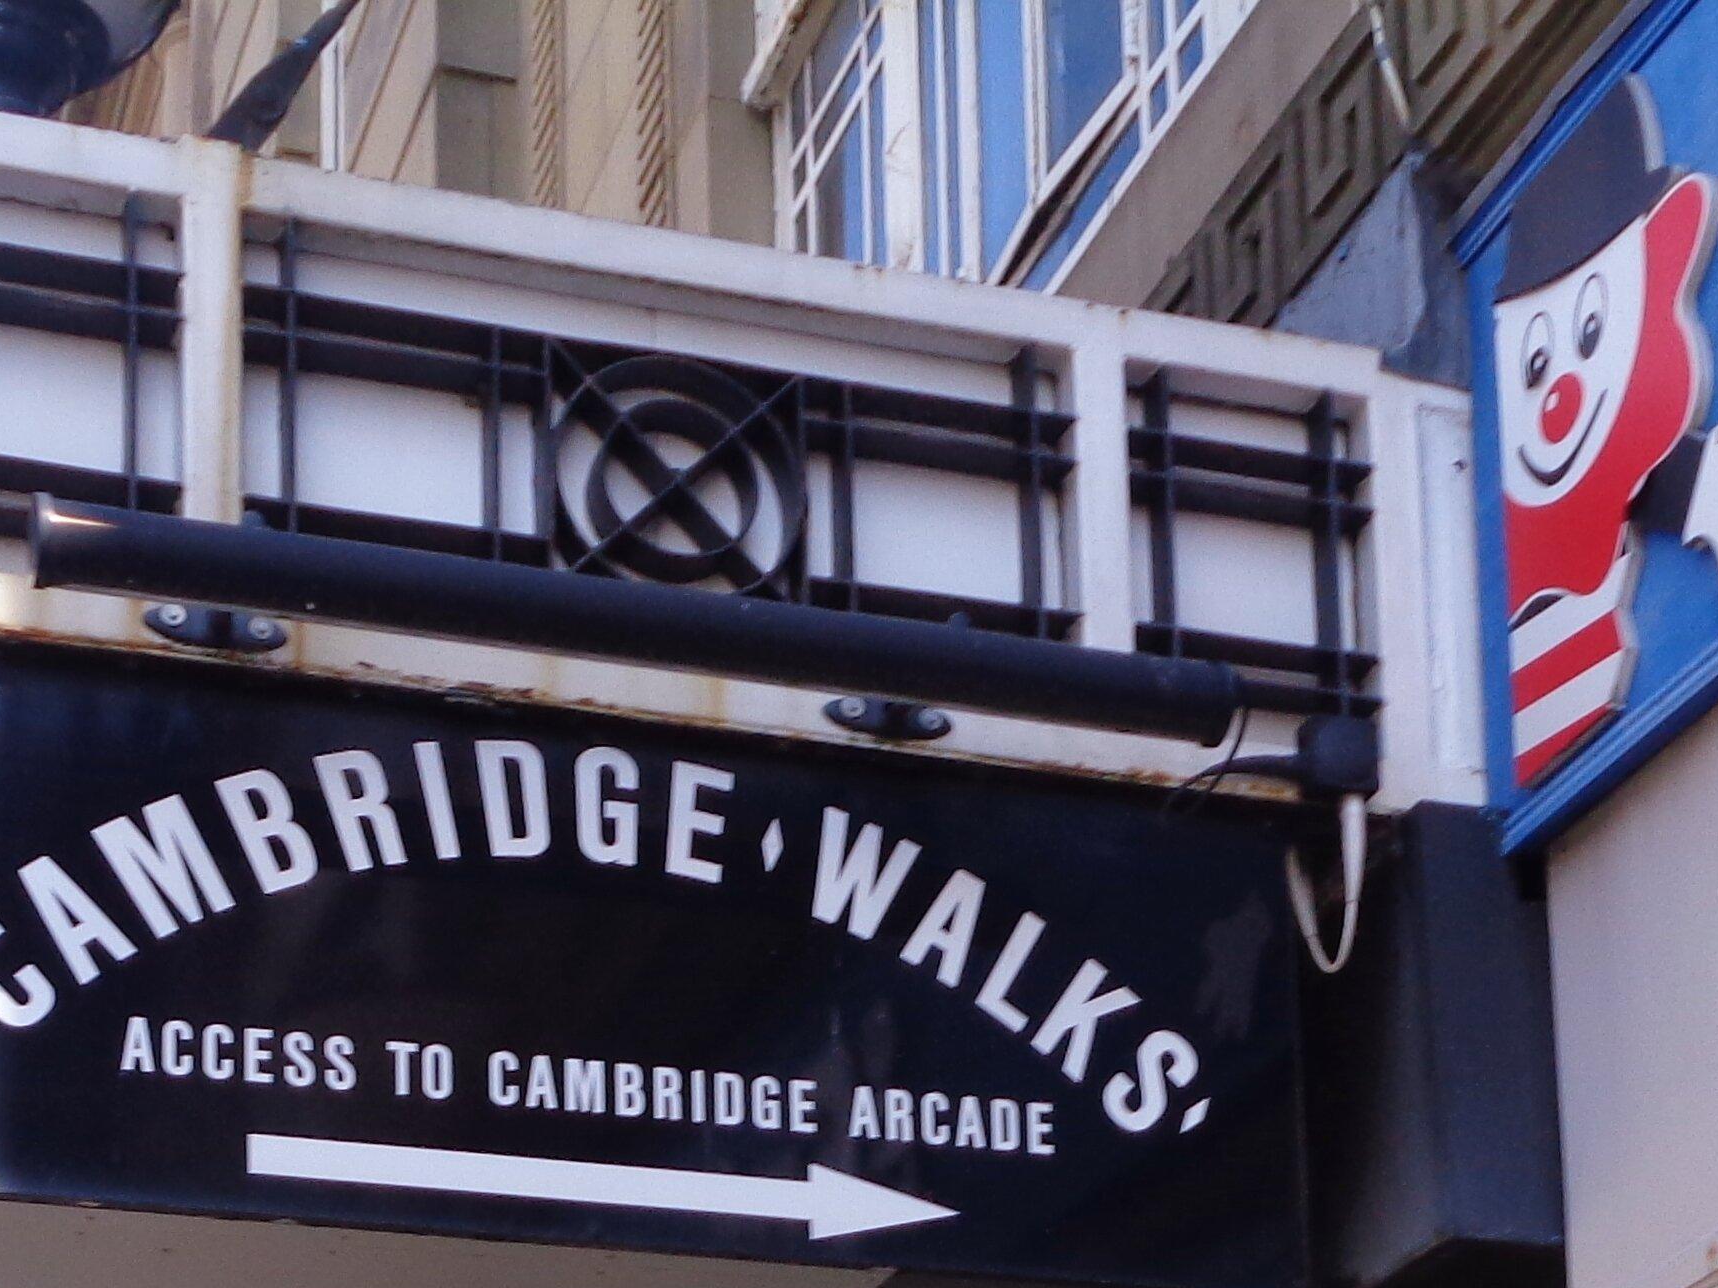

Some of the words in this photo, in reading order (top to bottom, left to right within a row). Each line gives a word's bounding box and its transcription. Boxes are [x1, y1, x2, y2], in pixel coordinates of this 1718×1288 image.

[122, 1016, 357, 1091] ACCESS
[386, 1042, 454, 1101] TO
[488, 1050, 819, 1133] CAMBRIDGE
[847, 1084, 1056, 1156] ARCADE
[810, 806, 1198, 1134] WALKS
